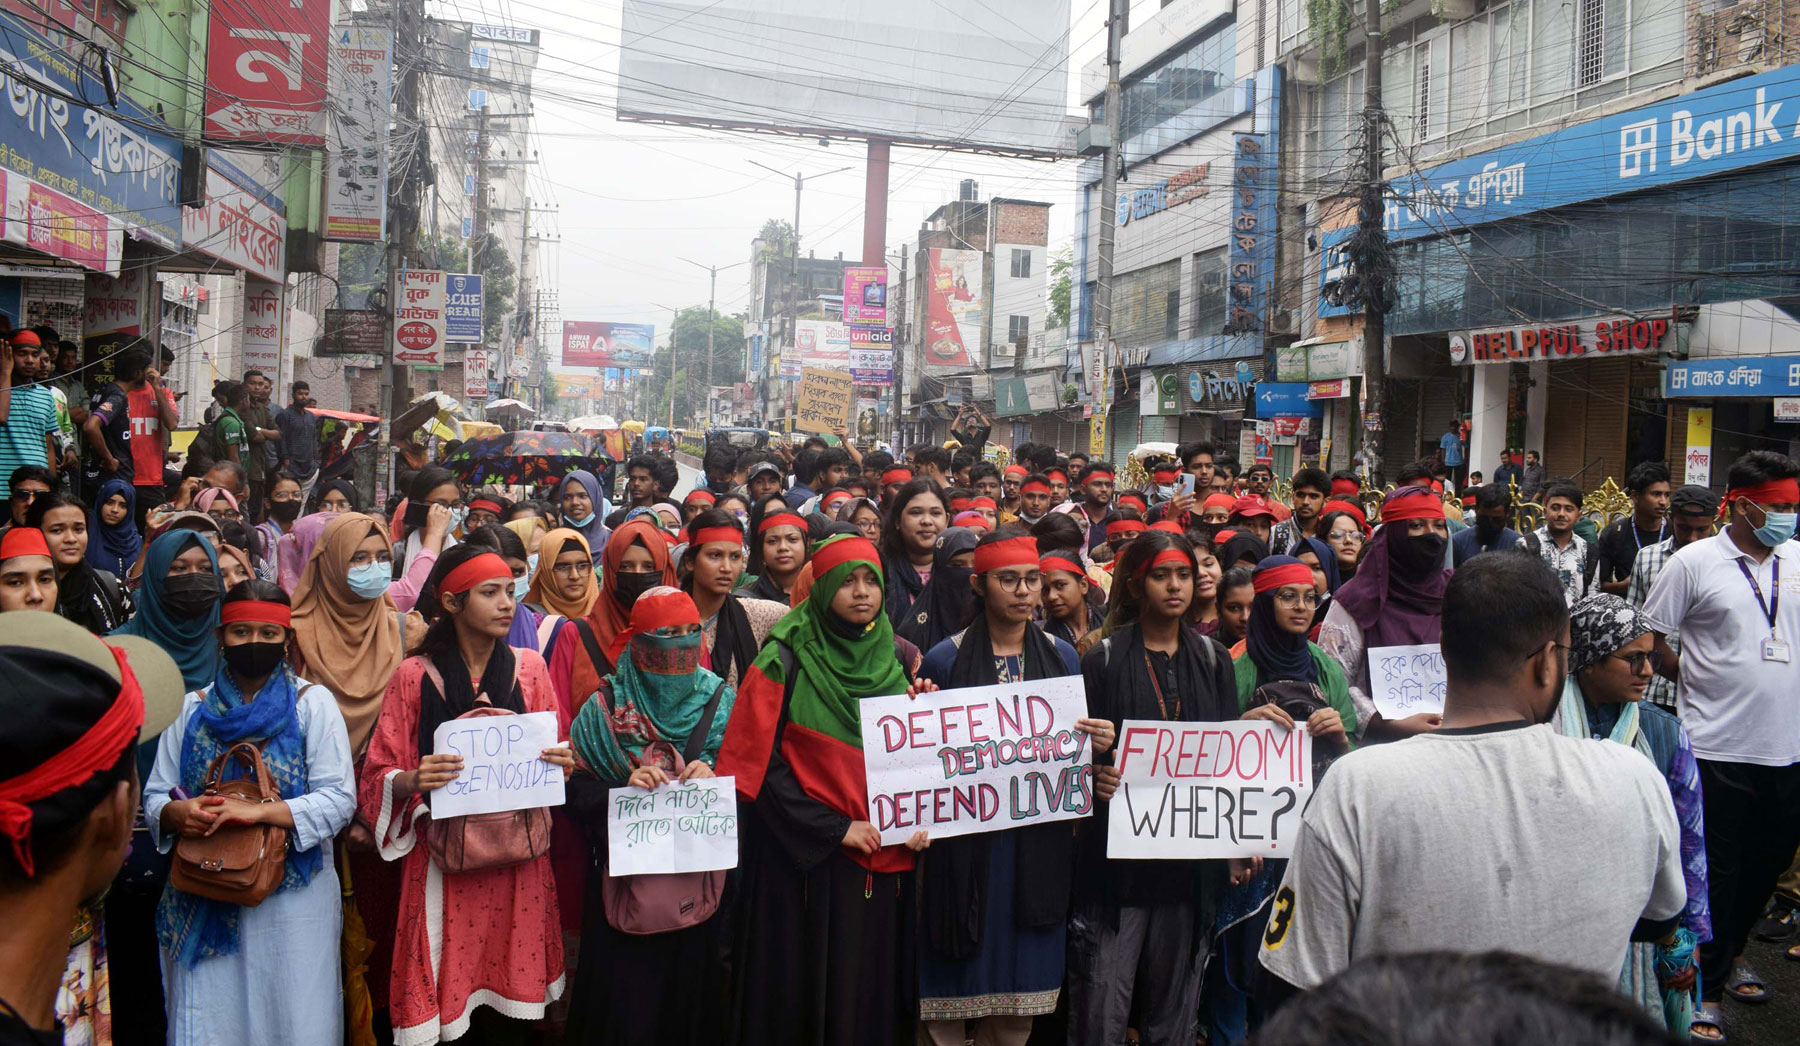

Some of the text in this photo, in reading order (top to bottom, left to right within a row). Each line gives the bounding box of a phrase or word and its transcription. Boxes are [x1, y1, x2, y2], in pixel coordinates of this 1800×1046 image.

[1671, 87, 1783, 166] Bank
[1466, 161, 1525, 208] এশিয়া
[247, 289, 279, 318] মনি
[406, 288, 430, 303] বুক
[445, 307, 480, 317] REAM
[568, 340, 589, 349] ISPAT
[852, 330, 891, 342] uniaid
[1473, 318, 1668, 360] HELPFUL SHOP
[1692, 366, 1762, 387] ব্যাংক এশিয়া
[1381, 656, 1406, 681] বুক
[1388, 678, 1448, 709] গুলি ক
[447, 724, 524, 757] STOP
[877, 695, 1054, 753] DEFEND
[937, 729, 1088, 780] DEMOCRACY
[1119, 728, 1304, 788] FREEDOM!
[446, 758, 559, 796] GENOSIDE
[616, 782, 720, 820] দিনে নাটক
[872, 763, 1093, 832] DEFEND LIVES
[1124, 782, 1297, 848] WHERE?
[626, 811, 736, 848] রাতে আটক
